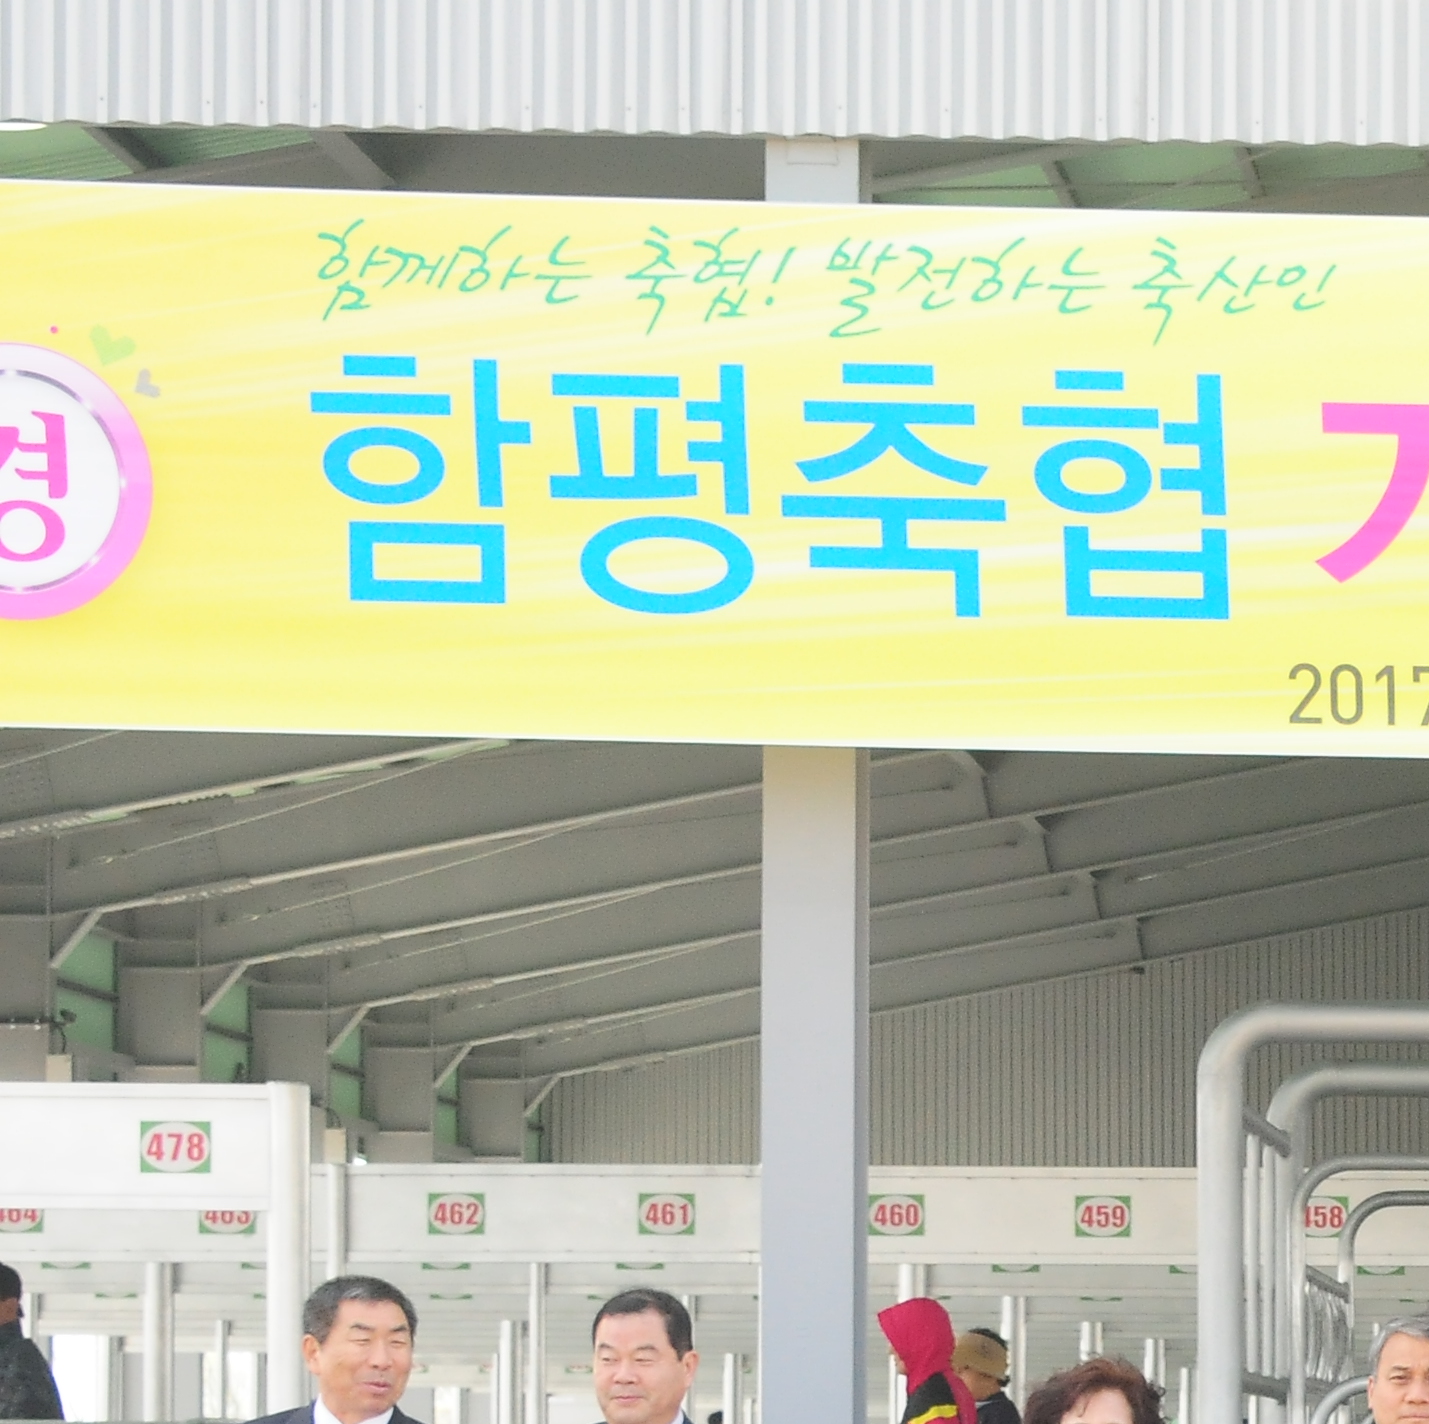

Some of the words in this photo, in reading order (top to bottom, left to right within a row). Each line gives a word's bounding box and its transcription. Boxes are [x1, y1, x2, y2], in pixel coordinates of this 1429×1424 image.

[316, 217, 592, 322] 함께하는
[624, 224, 797, 335] 축협!
[825, 236, 1106, 340] 발전하는
[1130, 235, 1338, 346] 축산인
[309, 353, 1231, 621] 함평축협
[145, 1131, 207, 1163] 478
[433, 1201, 480, 1226] 462
[645, 1201, 690, 1227] 461
[873, 1202, 921, 1228] 460
[1080, 1204, 1127, 1229] 459
